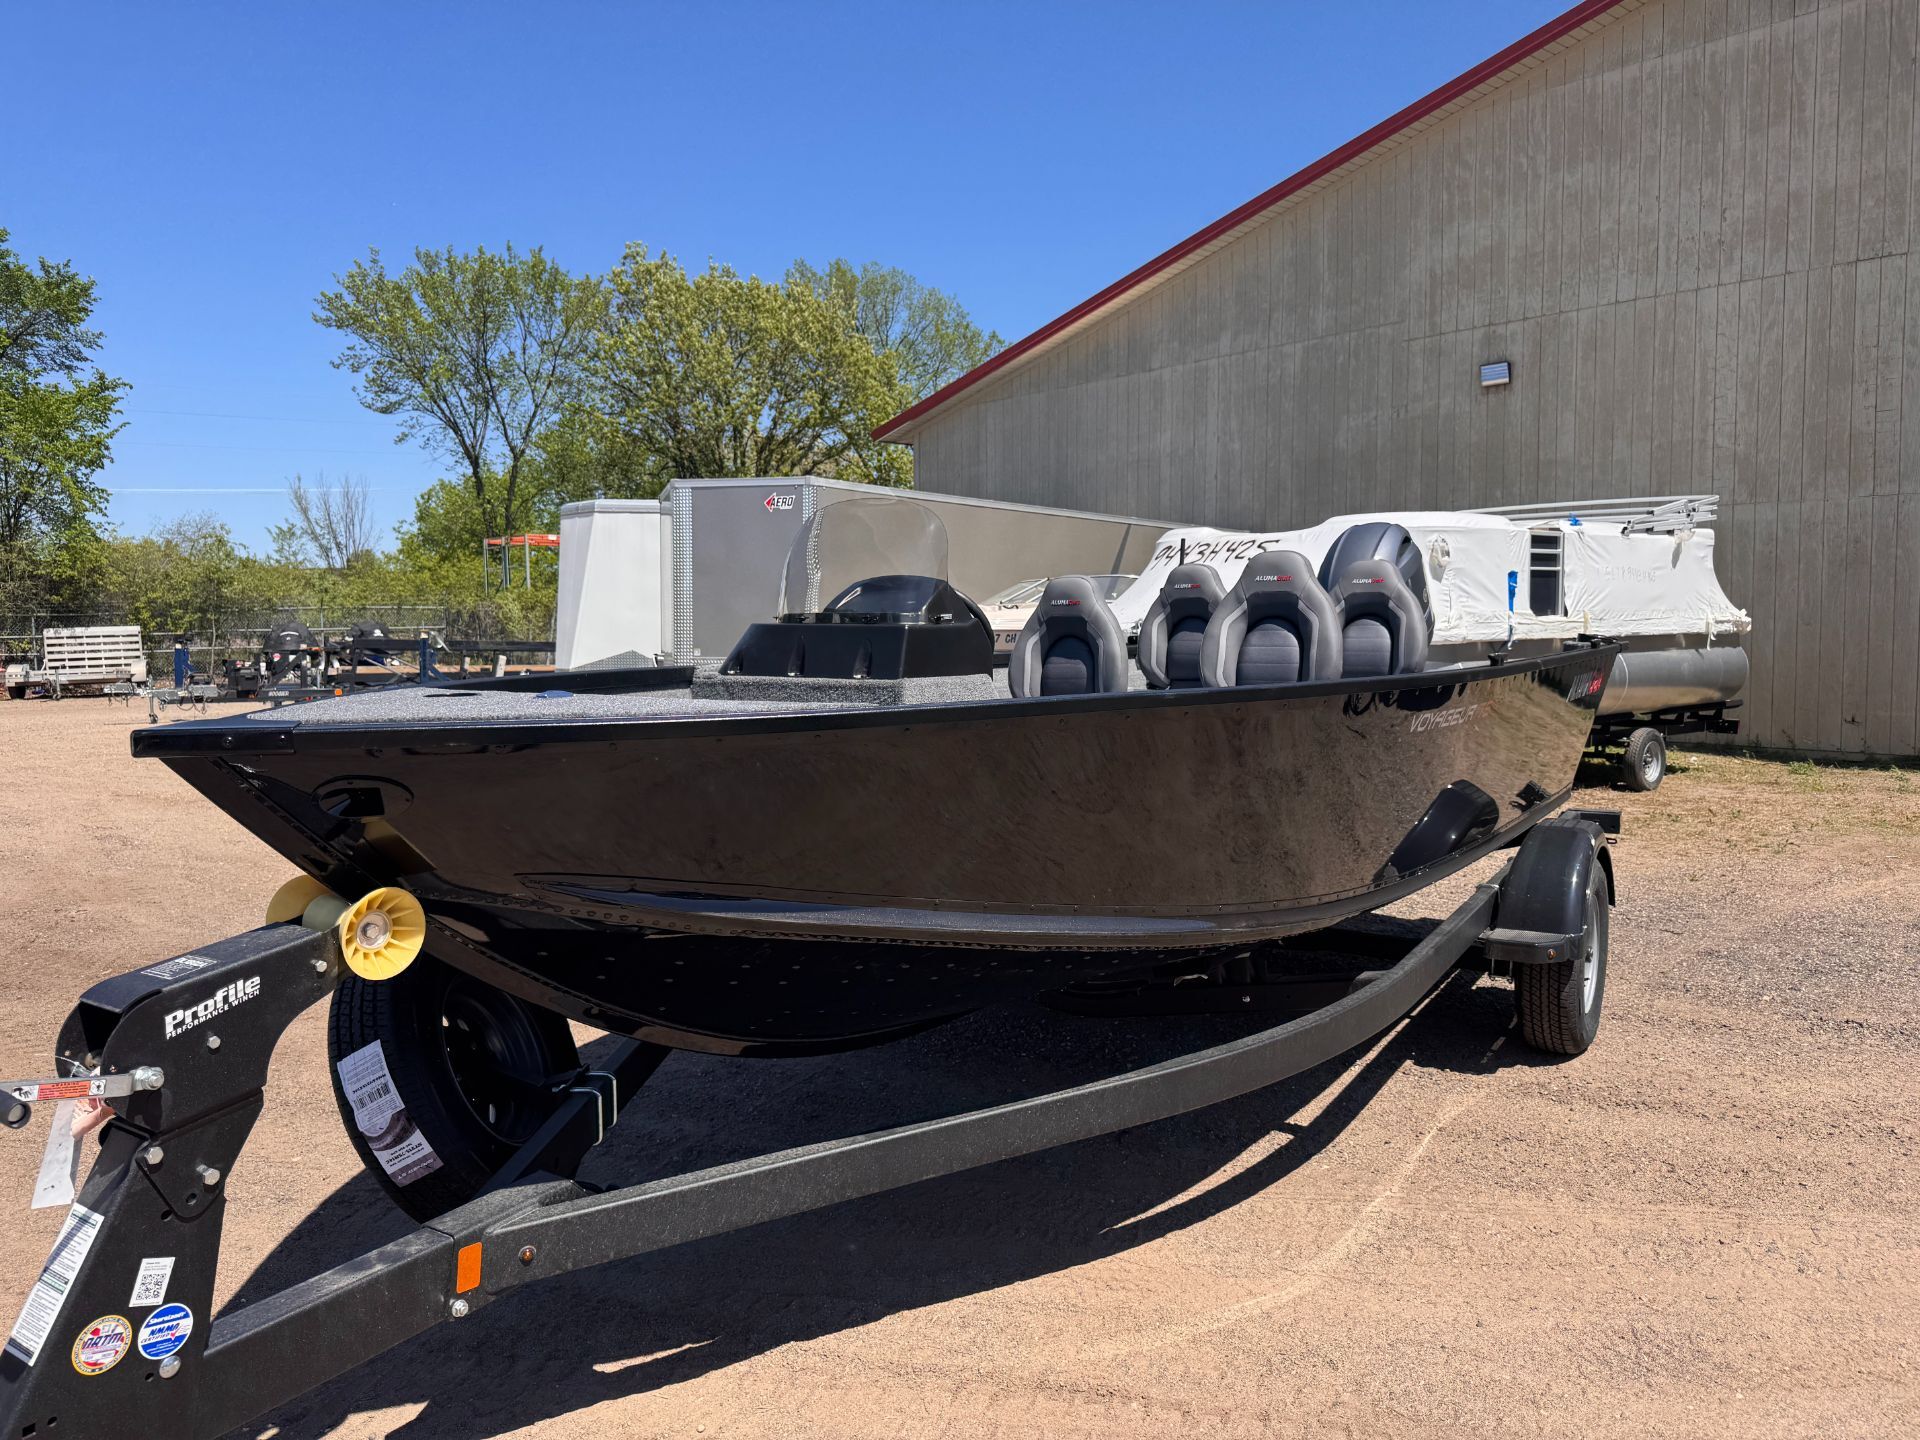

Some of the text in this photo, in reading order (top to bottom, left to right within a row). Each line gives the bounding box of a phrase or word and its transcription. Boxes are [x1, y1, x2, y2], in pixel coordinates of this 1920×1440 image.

[771, 497, 794, 507] AERO
[1005, 633, 1017, 643] CH
[1409, 704, 1478, 733] VOYAGEUR
[165, 976, 260, 1034] Profile
[166, 989, 260, 1040] PERFORMANCE WINCH
